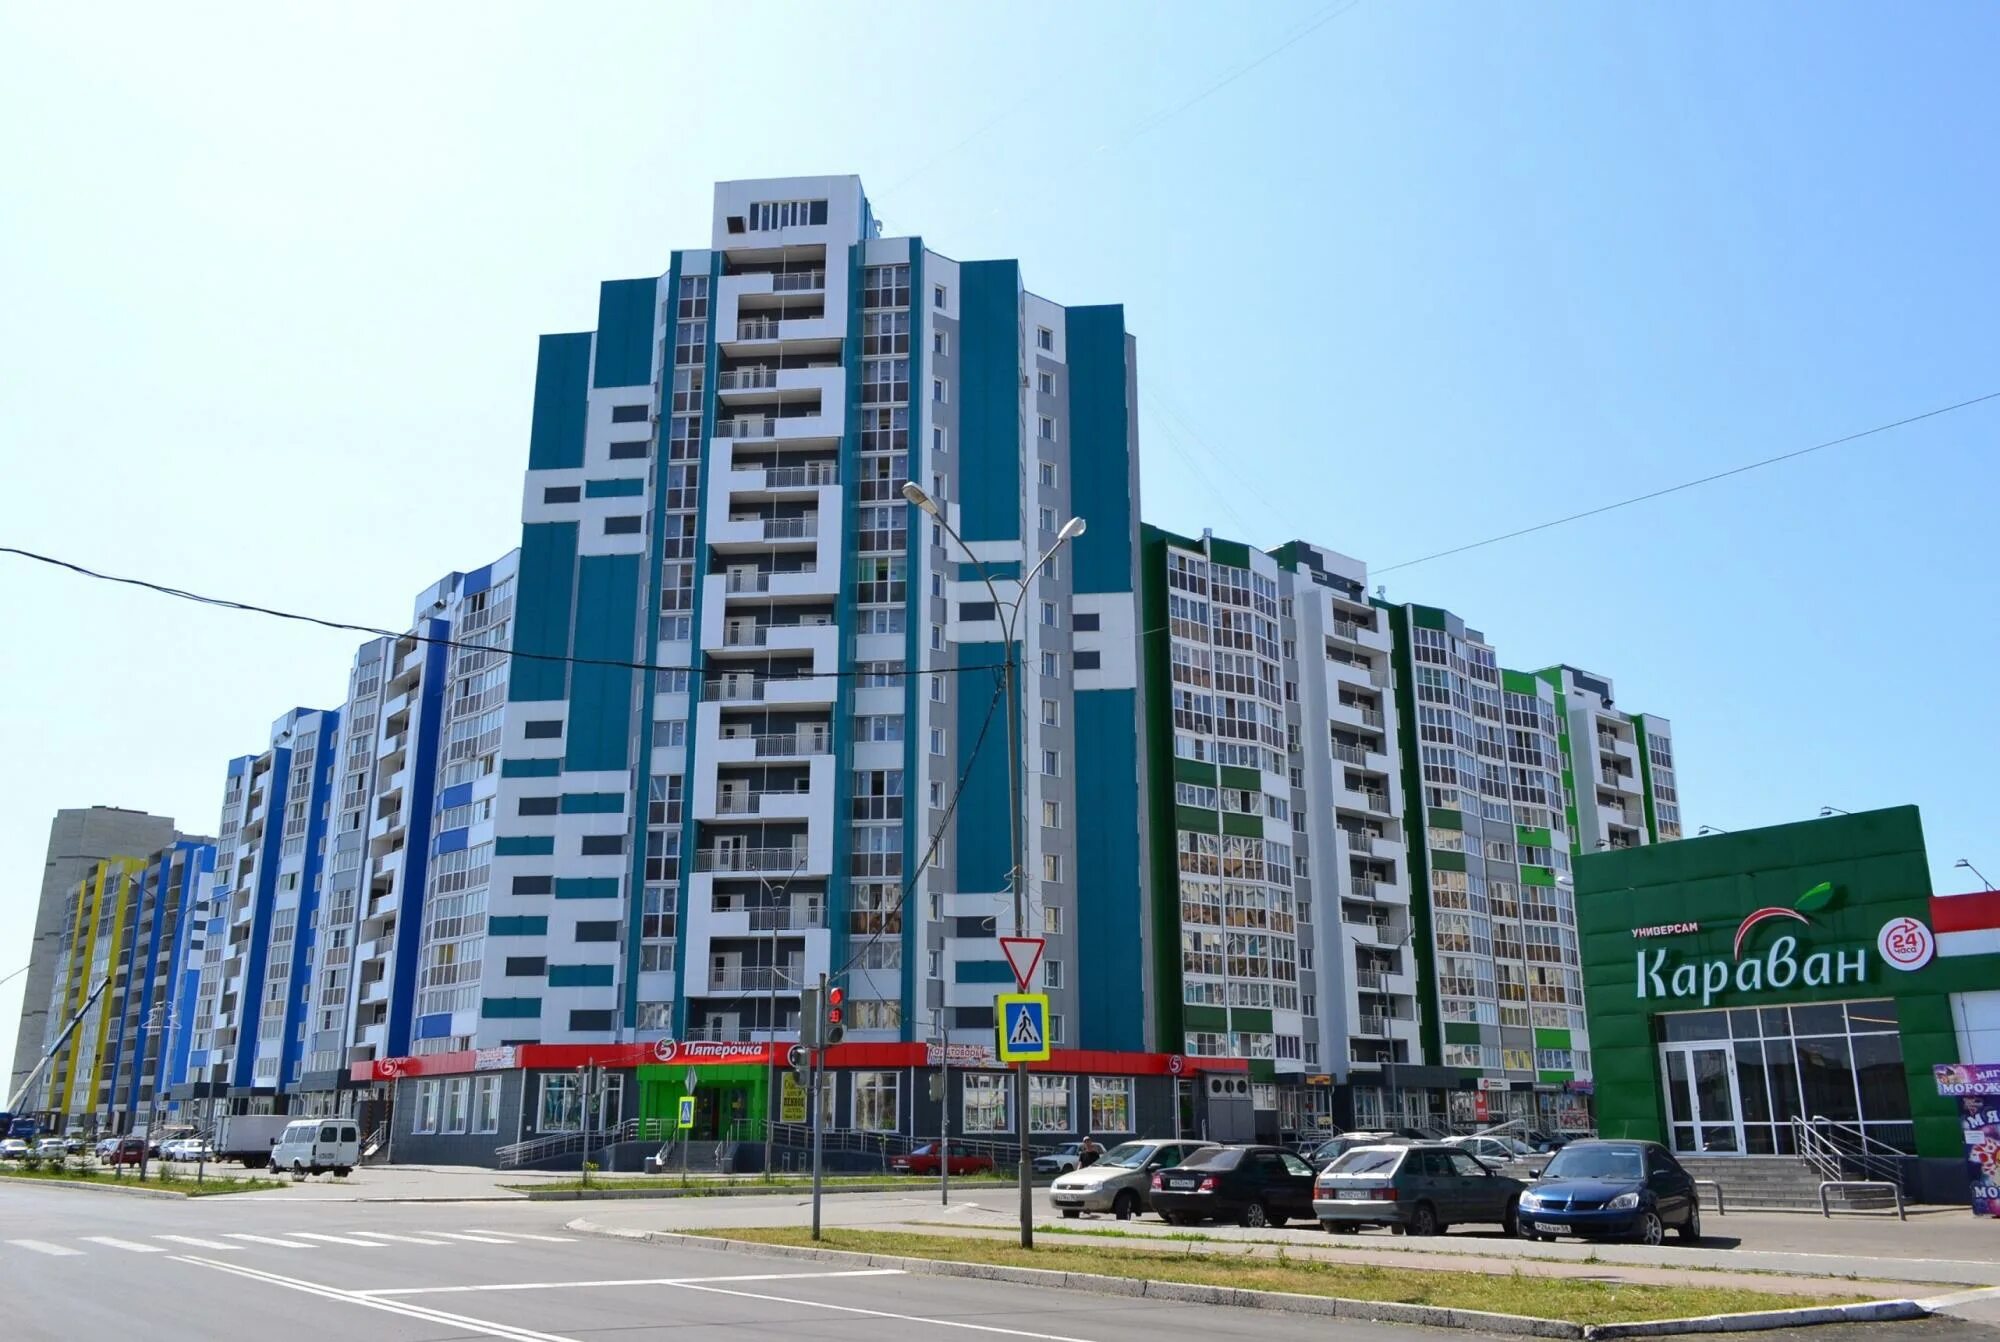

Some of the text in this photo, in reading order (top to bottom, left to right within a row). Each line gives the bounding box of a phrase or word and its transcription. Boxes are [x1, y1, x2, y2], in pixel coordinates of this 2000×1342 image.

[1631, 922, 1698, 938] УНИВЕРСАМ
[1892, 933, 1917, 949] 24
[1636, 936, 1866, 1006] Караван
[680, 1040, 763, 1060] Пятерочка
[1974, 1186, 2000, 1198] МО
